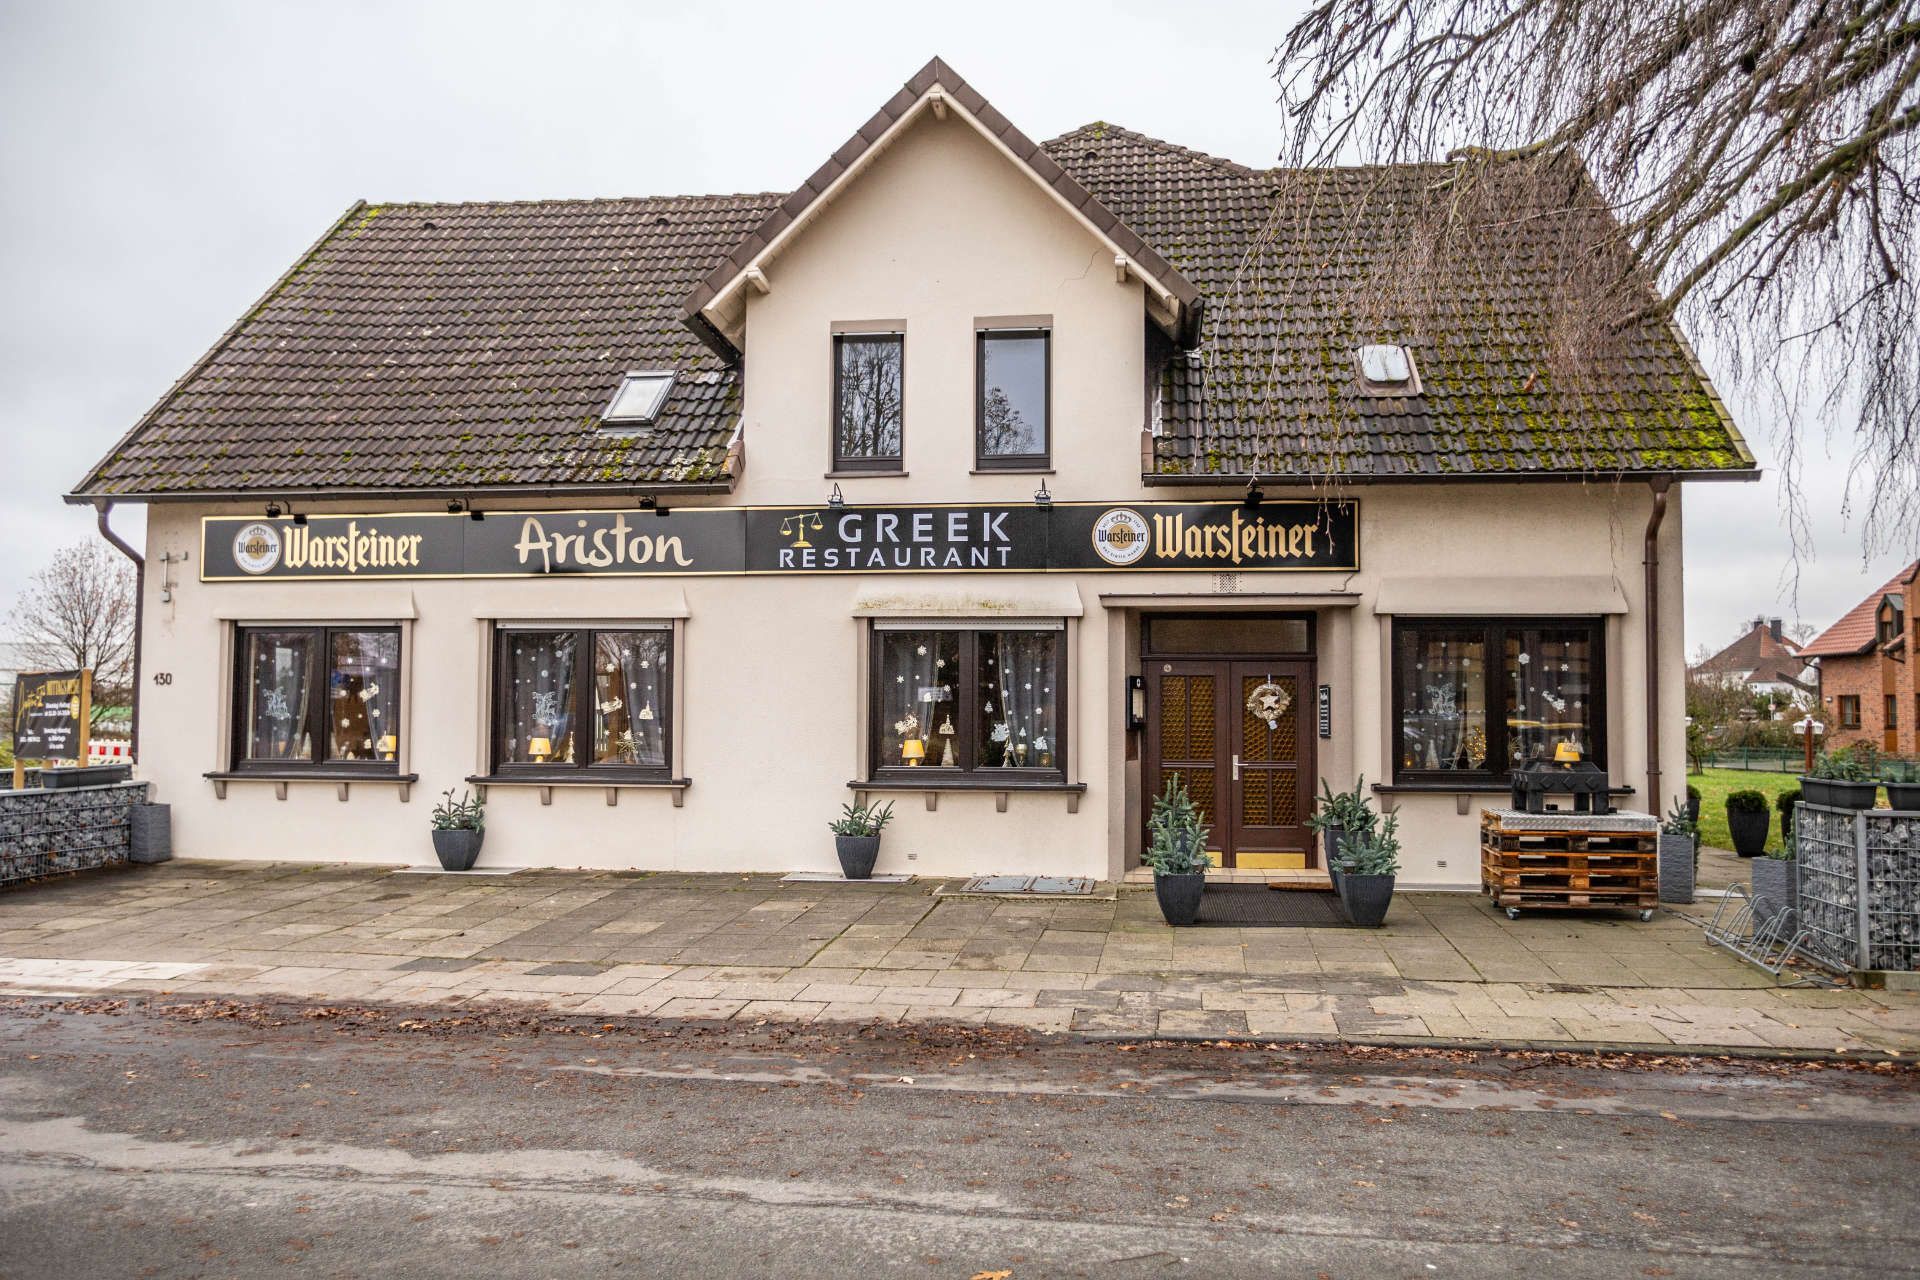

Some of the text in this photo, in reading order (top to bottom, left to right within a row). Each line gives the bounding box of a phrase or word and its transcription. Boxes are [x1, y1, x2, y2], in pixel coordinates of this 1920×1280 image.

[514, 512, 694, 574] Ariston
[838, 512, 1011, 543] GREEK
[1098, 528, 1145, 544] Warsteiner
[1153, 508, 1319, 565] Warsteiner
[283, 520, 422, 573] Warsteiner
[779, 546, 1012, 568] RESTAURANT
[153, 672, 173, 686] 130
